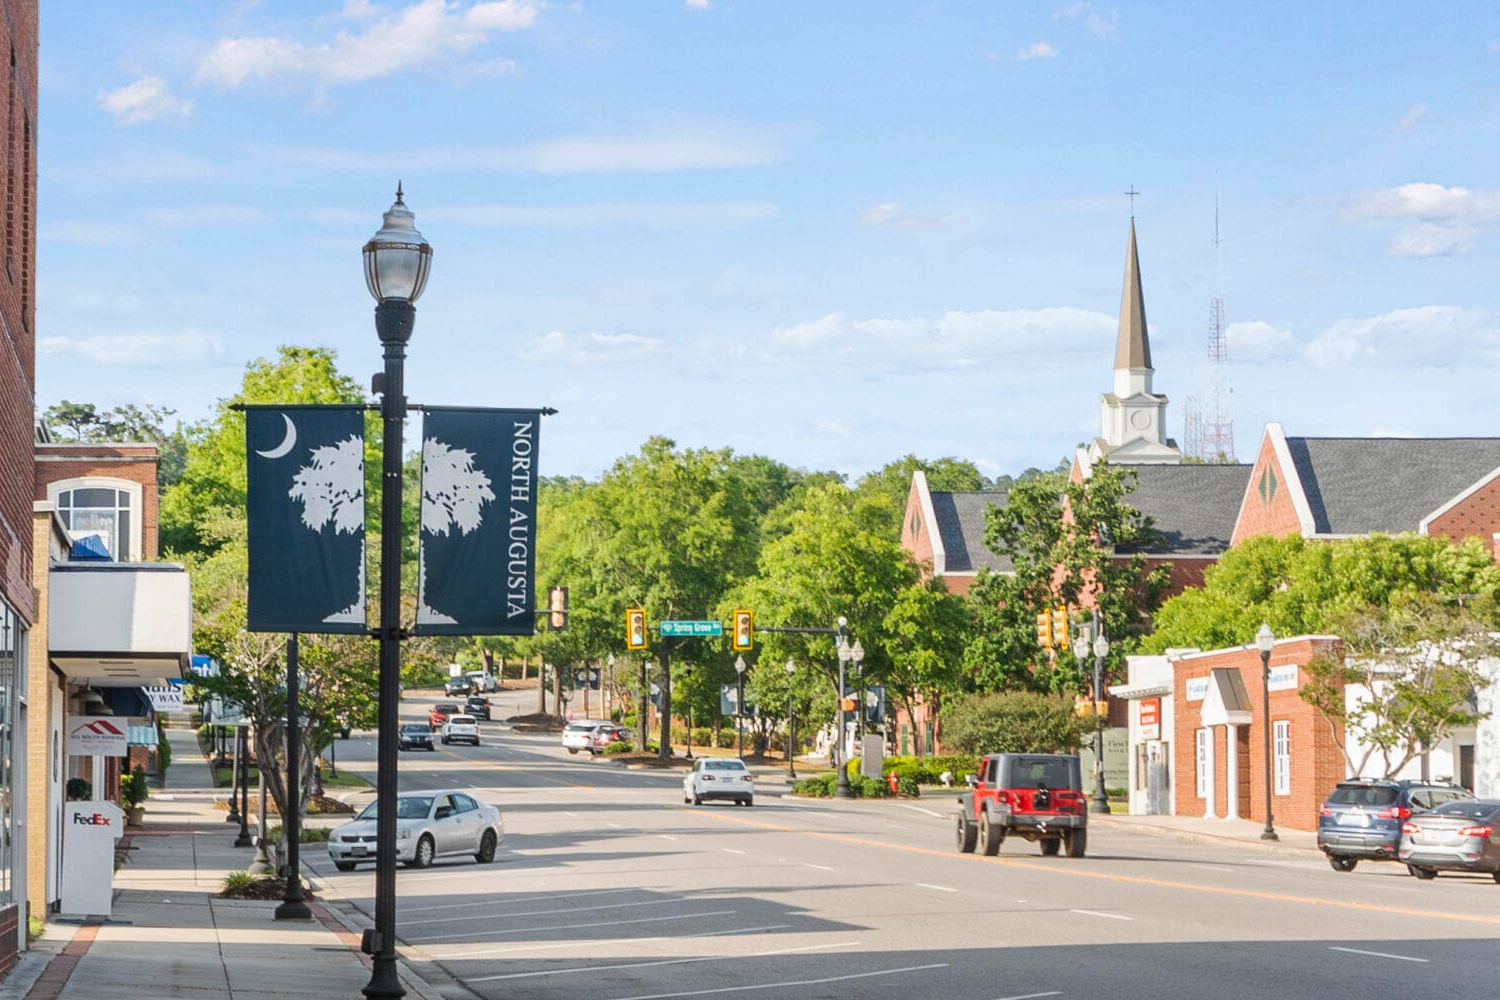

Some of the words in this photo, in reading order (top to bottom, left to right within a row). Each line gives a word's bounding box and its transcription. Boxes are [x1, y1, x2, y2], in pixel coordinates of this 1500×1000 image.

[510, 420, 533, 502] NORTH
[506, 507, 529, 620] AUGUSTA
[674, 623, 693, 635] Spring
[694, 623, 712, 632] Grove
[158, 694, 182, 703] WAX
[73, 812, 111, 826] FedEx
